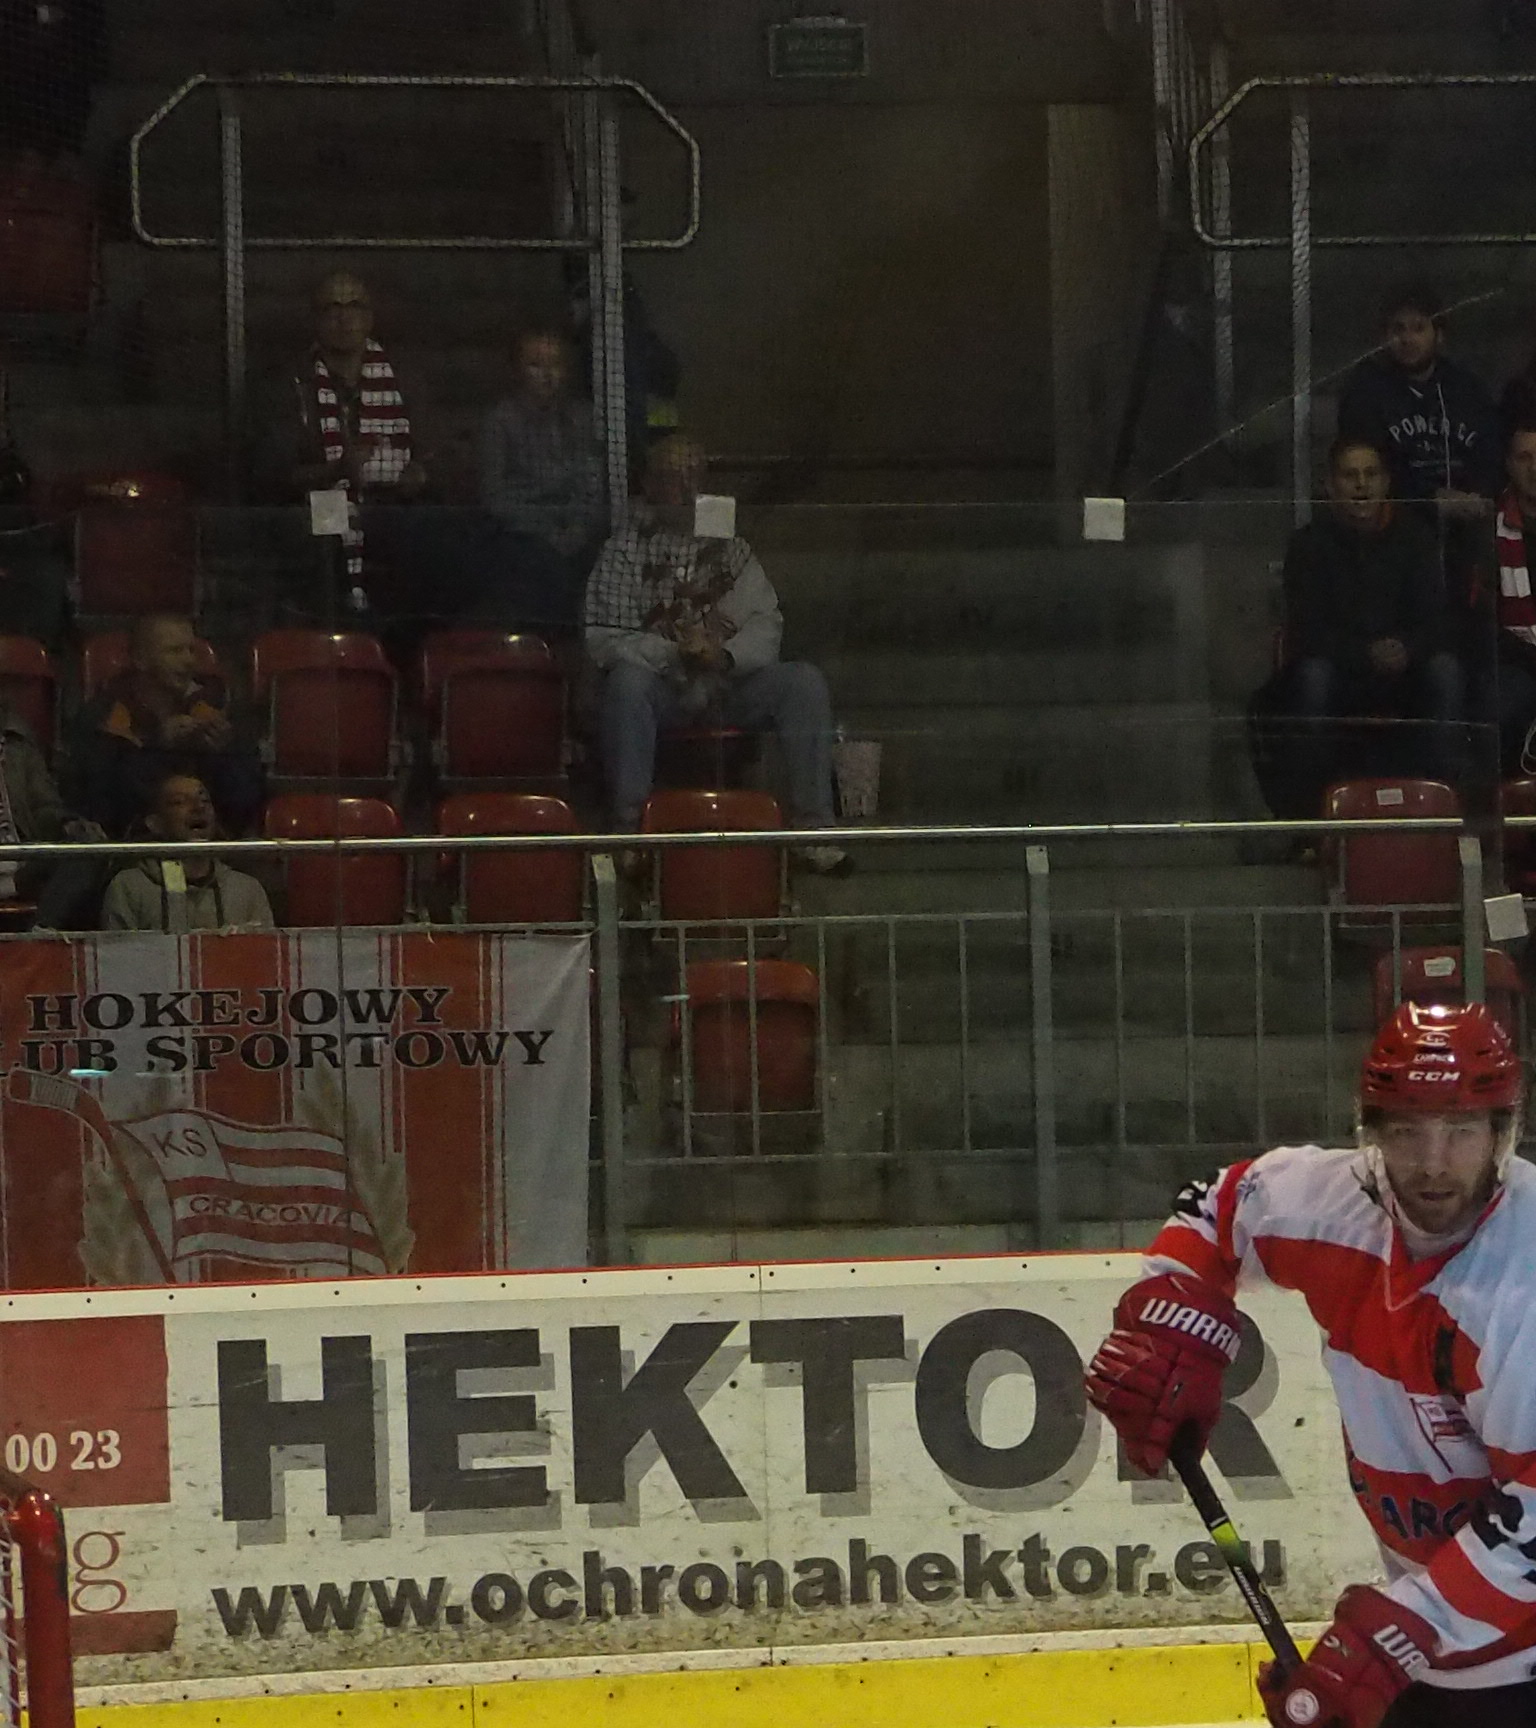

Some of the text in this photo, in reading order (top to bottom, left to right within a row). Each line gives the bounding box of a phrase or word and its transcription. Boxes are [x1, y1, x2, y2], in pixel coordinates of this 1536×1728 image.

[28, 987, 453, 1032] HOKEJOWY
[146, 1030, 555, 1072] SPORTOWY
[1408, 1071, 1460, 1081] CCM
[157, 1129, 208, 1160] KS
[189, 1195, 353, 1227] CRACOVIA
[70, 1429, 122, 1470] 23
[211, 1533, 1286, 1638] www.ochronahektor.eu
